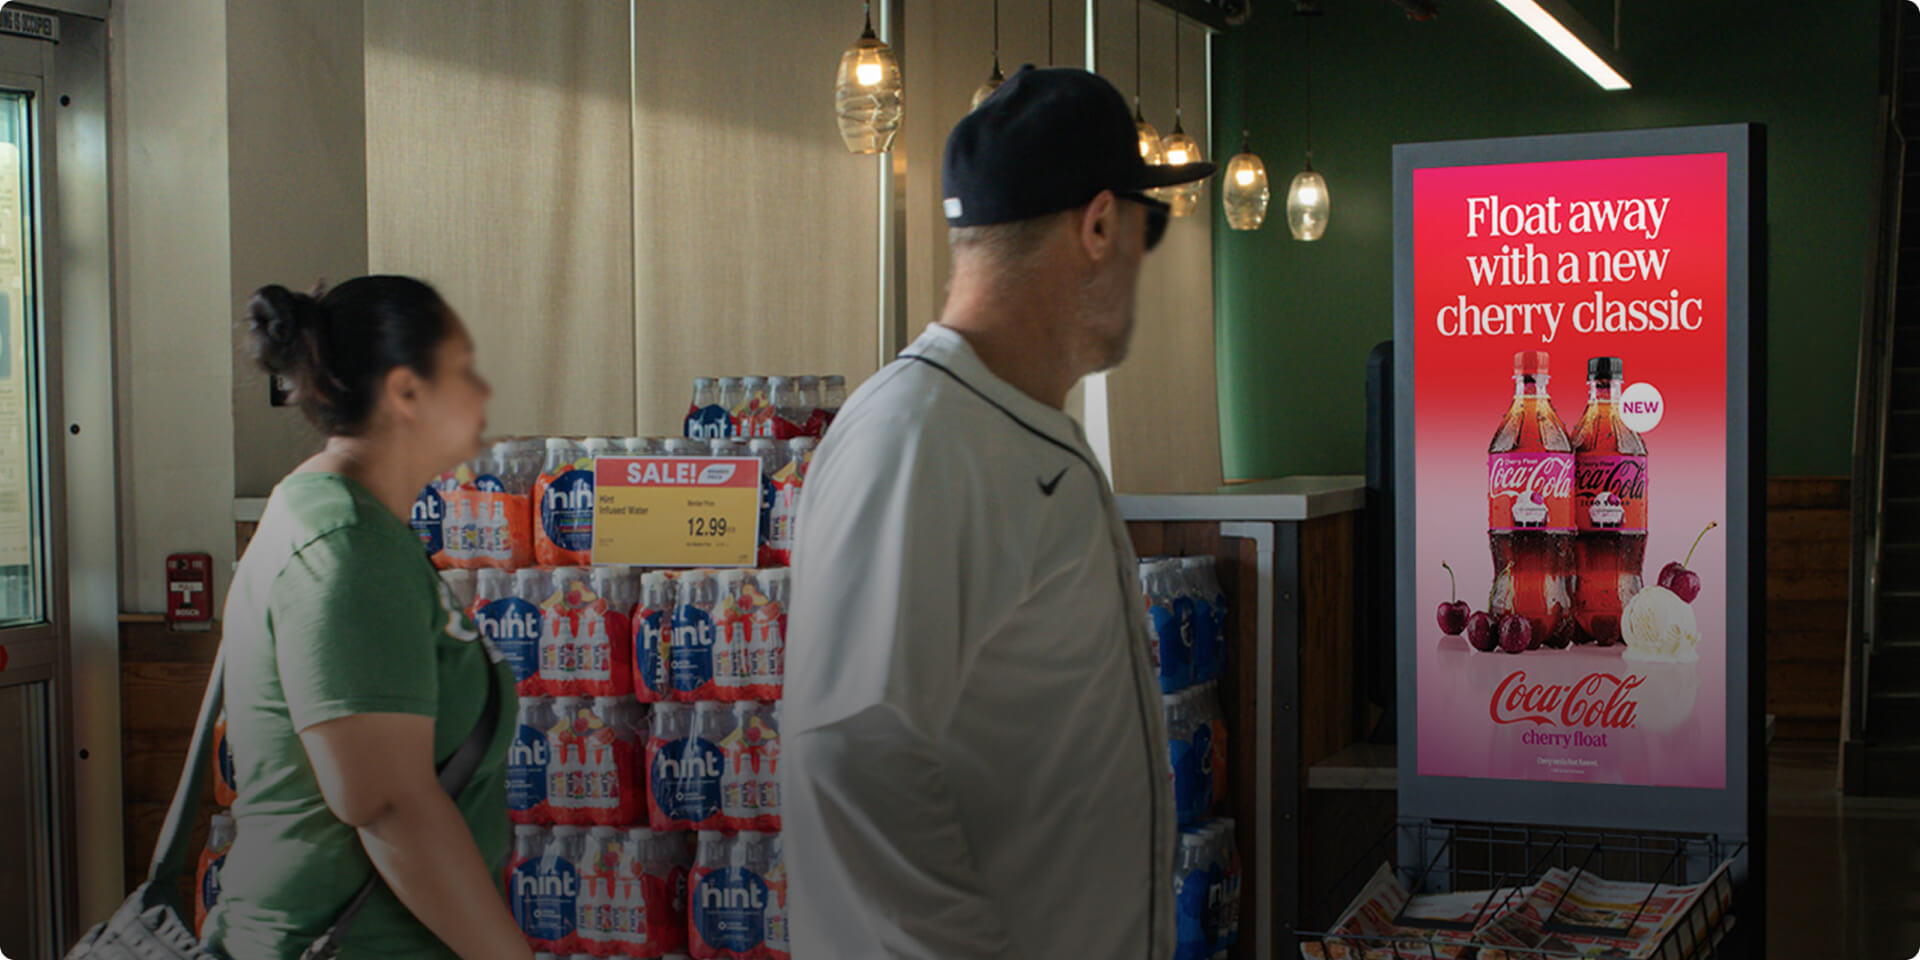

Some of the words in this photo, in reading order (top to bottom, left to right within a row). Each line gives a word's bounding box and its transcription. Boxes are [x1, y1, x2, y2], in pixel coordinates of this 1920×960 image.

[1466, 196, 1561, 238] Float
[1569, 198, 1670, 239] away
[1466, 244, 1550, 286] with
[1557, 252, 1580, 284] a
[1588, 249, 1670, 283] new
[1437, 296, 1565, 343] cherry
[1572, 289, 1703, 334] classic
[1623, 401, 1659, 414] NEW
[627, 462, 697, 484] SALE!
[1490, 457, 1573, 498] Coca-Cola
[411, 495, 441, 519] nt
[549, 487, 593, 509] hin
[687, 517, 727, 536] 12.99
[478, 612, 538, 639] hint
[1489, 670, 1647, 729] Coca-Cola
[507, 739, 547, 766] int
[1522, 730, 1573, 749] cherry
[1574, 731, 1608, 748] float
[658, 751, 720, 778] hint
[516, 870, 577, 897] hint
[701, 879, 764, 909] hint
